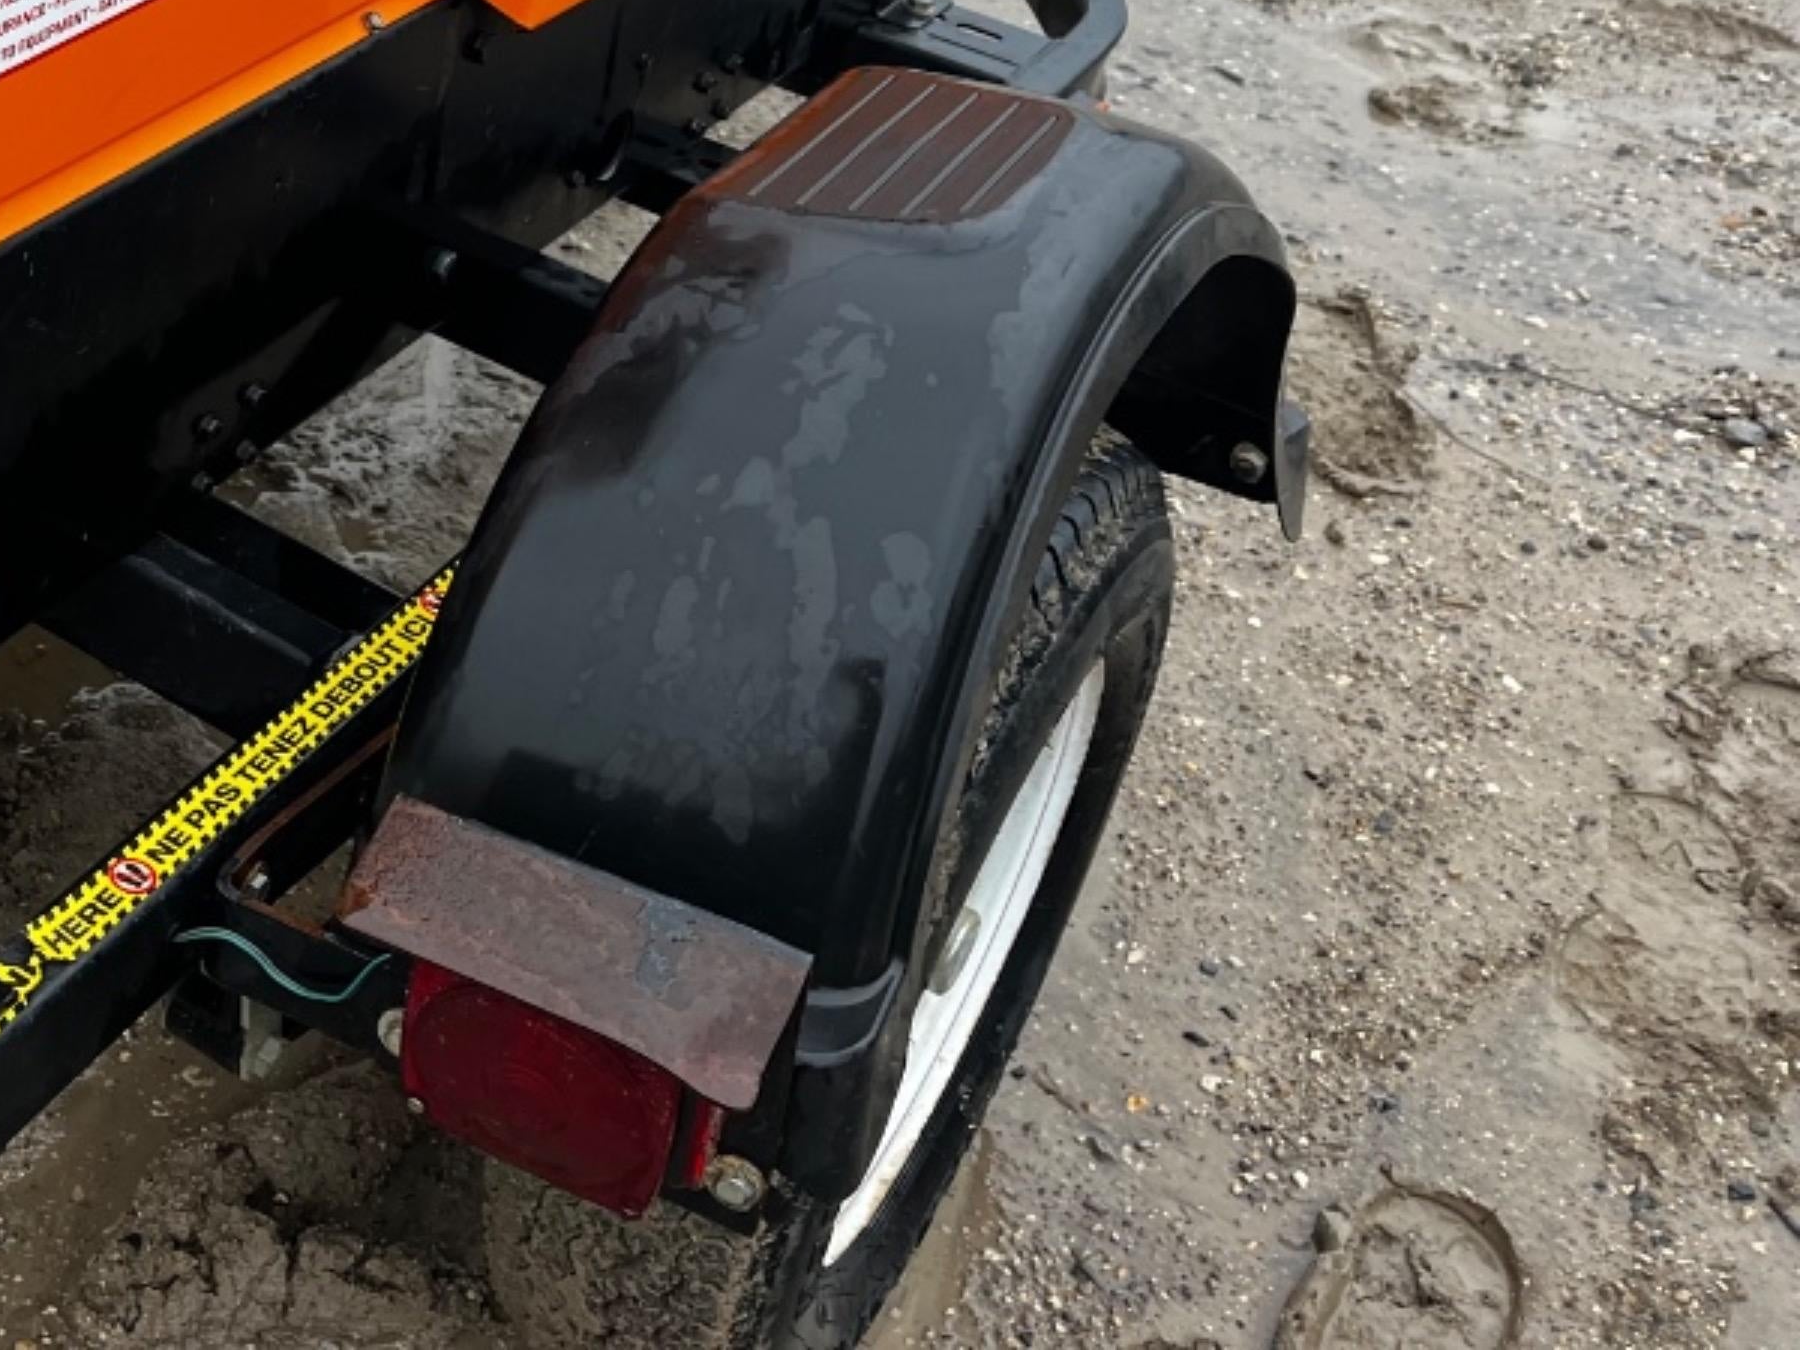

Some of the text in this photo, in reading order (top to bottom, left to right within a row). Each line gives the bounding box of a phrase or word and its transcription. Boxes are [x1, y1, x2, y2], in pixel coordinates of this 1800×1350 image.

[145, 614, 431, 867] NE PAS TENEZ DEBOUT ICI
[45, 889, 125, 952] HERE
